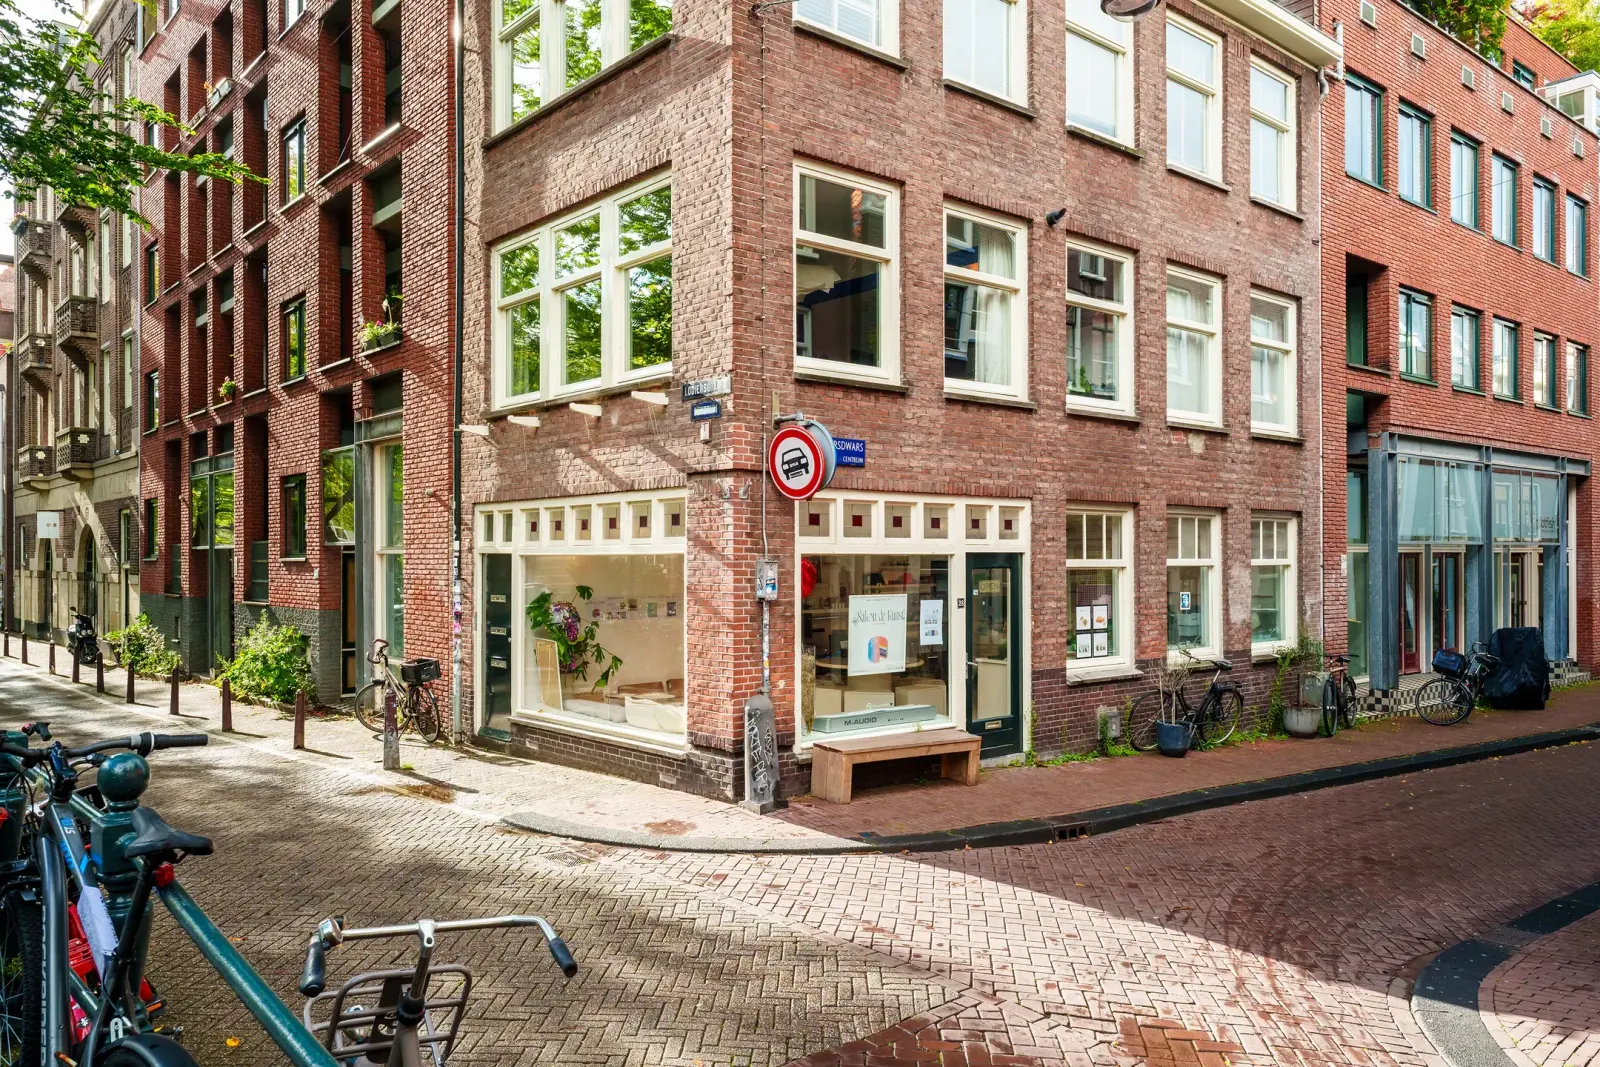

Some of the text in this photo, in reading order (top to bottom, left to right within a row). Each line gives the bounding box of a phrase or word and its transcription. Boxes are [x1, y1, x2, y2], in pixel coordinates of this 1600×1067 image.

[834, 440, 864, 452] RSDWARS
[842, 455, 864, 463] CENTRUM
[845, 717, 877, 727] M-AUDIO
